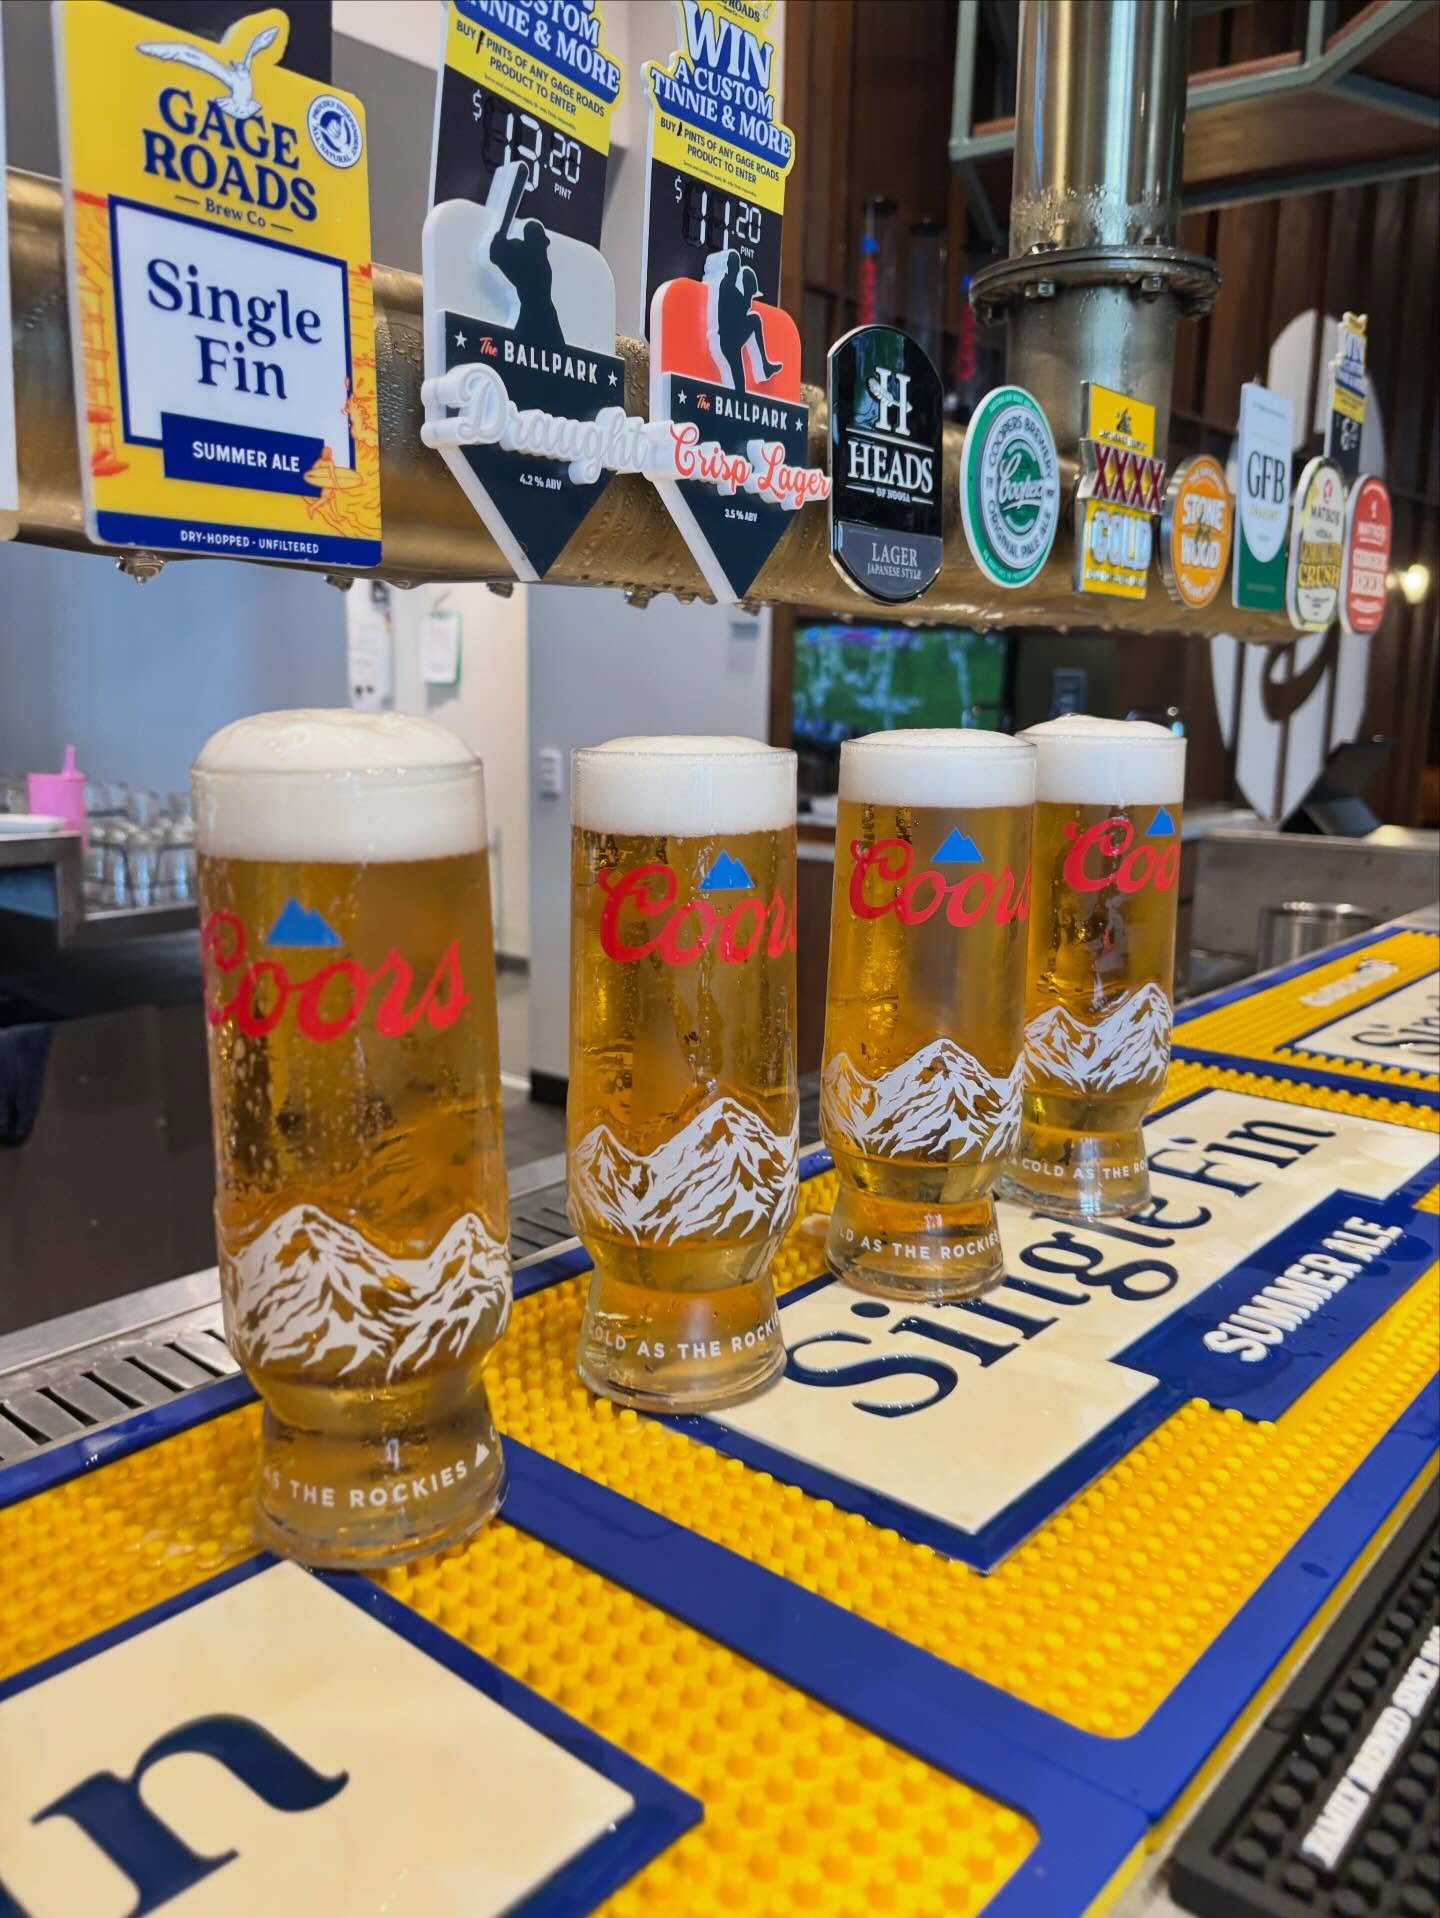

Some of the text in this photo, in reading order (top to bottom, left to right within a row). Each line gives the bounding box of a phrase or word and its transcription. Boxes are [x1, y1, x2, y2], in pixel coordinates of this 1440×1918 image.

[456, 20, 476, 39] BUY
[486, 37, 512, 62] PINTS
[514, 55, 528, 69] OF
[530, 64, 549, 83] ANY
[551, 77, 575, 97] GAGE
[576, 93, 605, 117] ROADS
[534, 20, 551, 49] &
[556, 30, 620, 92] MORE
[683, 0, 773, 88] WIN
[473, 89, 483, 122] $
[490, 56, 534, 89] PRODUCT
[536, 82, 548, 98] TO
[550, 91, 576, 116] ENTER
[675, 60, 774, 120] A CUSTOM
[158, 87, 300, 170] GAGE
[652, 70, 791, 158] TINNIE & MORE
[142, 129, 319, 222] ROADS
[660, 117, 676, 133] BUY
[684, 128, 705, 146] PINTS
[707, 140, 717, 152] OF
[719, 145, 735, 159] ANY
[736, 153, 755, 169] GAGE
[756, 163, 779, 182] ROADS
[687, 144, 722, 168] PRODUCT
[724, 161, 734, 174] TO
[736, 167, 757, 185] ENTER
[205, 197, 267, 229] Brew Co
[554, 183, 572, 200] PINT
[674, 175, 683, 204] $
[740, 245, 755, 258] PINT
[147, 257, 323, 347] Single
[195, 334, 287, 400] Fin
[480, 336, 598, 385] The BALLPARK
[442, 366, 654, 480] Draught
[697, 393, 788, 431] The BALLPARK
[192, 440, 301, 473] SUMMER ALE
[670, 423, 831, 508] Crisp Lager
[848, 440, 934, 494] HEADS
[989, 415, 1023, 466] COOPERS
[545, 478, 562, 490] ABV
[1092, 442, 1165, 513] XXXX
[1247, 450, 1286, 505] GFB
[180, 529, 320, 556] DRY-HOPPED UNFILTERED
[744, 512, 758, 523] ABV
[987, 500, 1018, 559] ORIGINAL
[1022, 537, 1041, 558] PALE
[1090, 510, 1152, 570] GOLD
[867, 562, 922, 581] JAPANESE STYLE
[872, 542, 918, 567] LAGER
[1299, 563, 1341, 590] CRUSH
[202, 910, 473, 1044] Coors
[1022, 1158, 1064, 1177] COLD
[1073, 1167, 1095, 1180] AS
[1102, 1165, 1130, 1180] THE
[1148, 1119, 1336, 1198] Fin
[860, 1235, 882, 1253] AS
[892, 1242, 931, 1260] THE
[783, 1196, 1212, 1418] Single
[1203, 1216, 1404, 1362] SUMMER ALE
[637, 1340, 665, 1359] AS
[677, 1341, 721, 1360] THE
[289, 1479, 336, 1508] THE
[350, 1459, 468, 1508] ROCKIES
